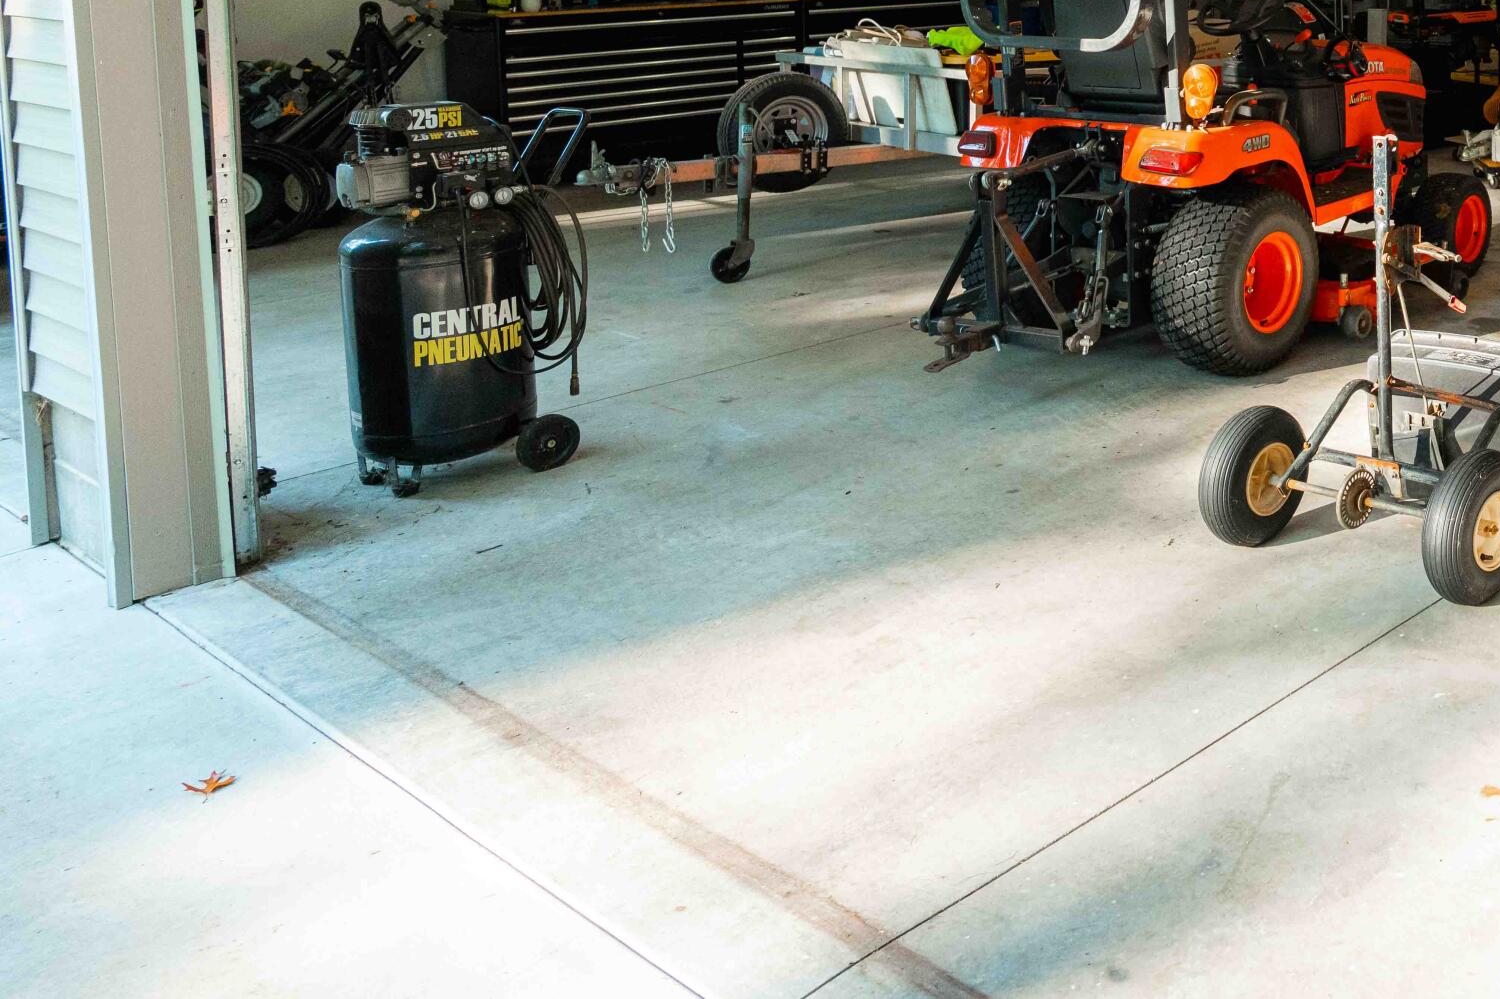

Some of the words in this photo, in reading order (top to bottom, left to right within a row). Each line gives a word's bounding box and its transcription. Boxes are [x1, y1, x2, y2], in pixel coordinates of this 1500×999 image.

[438, 110, 462, 128] PSI
[1242, 134, 1271, 152] 4WD
[413, 296, 521, 339] CENTRAL
[414, 321, 522, 367] PNEUMATIC
